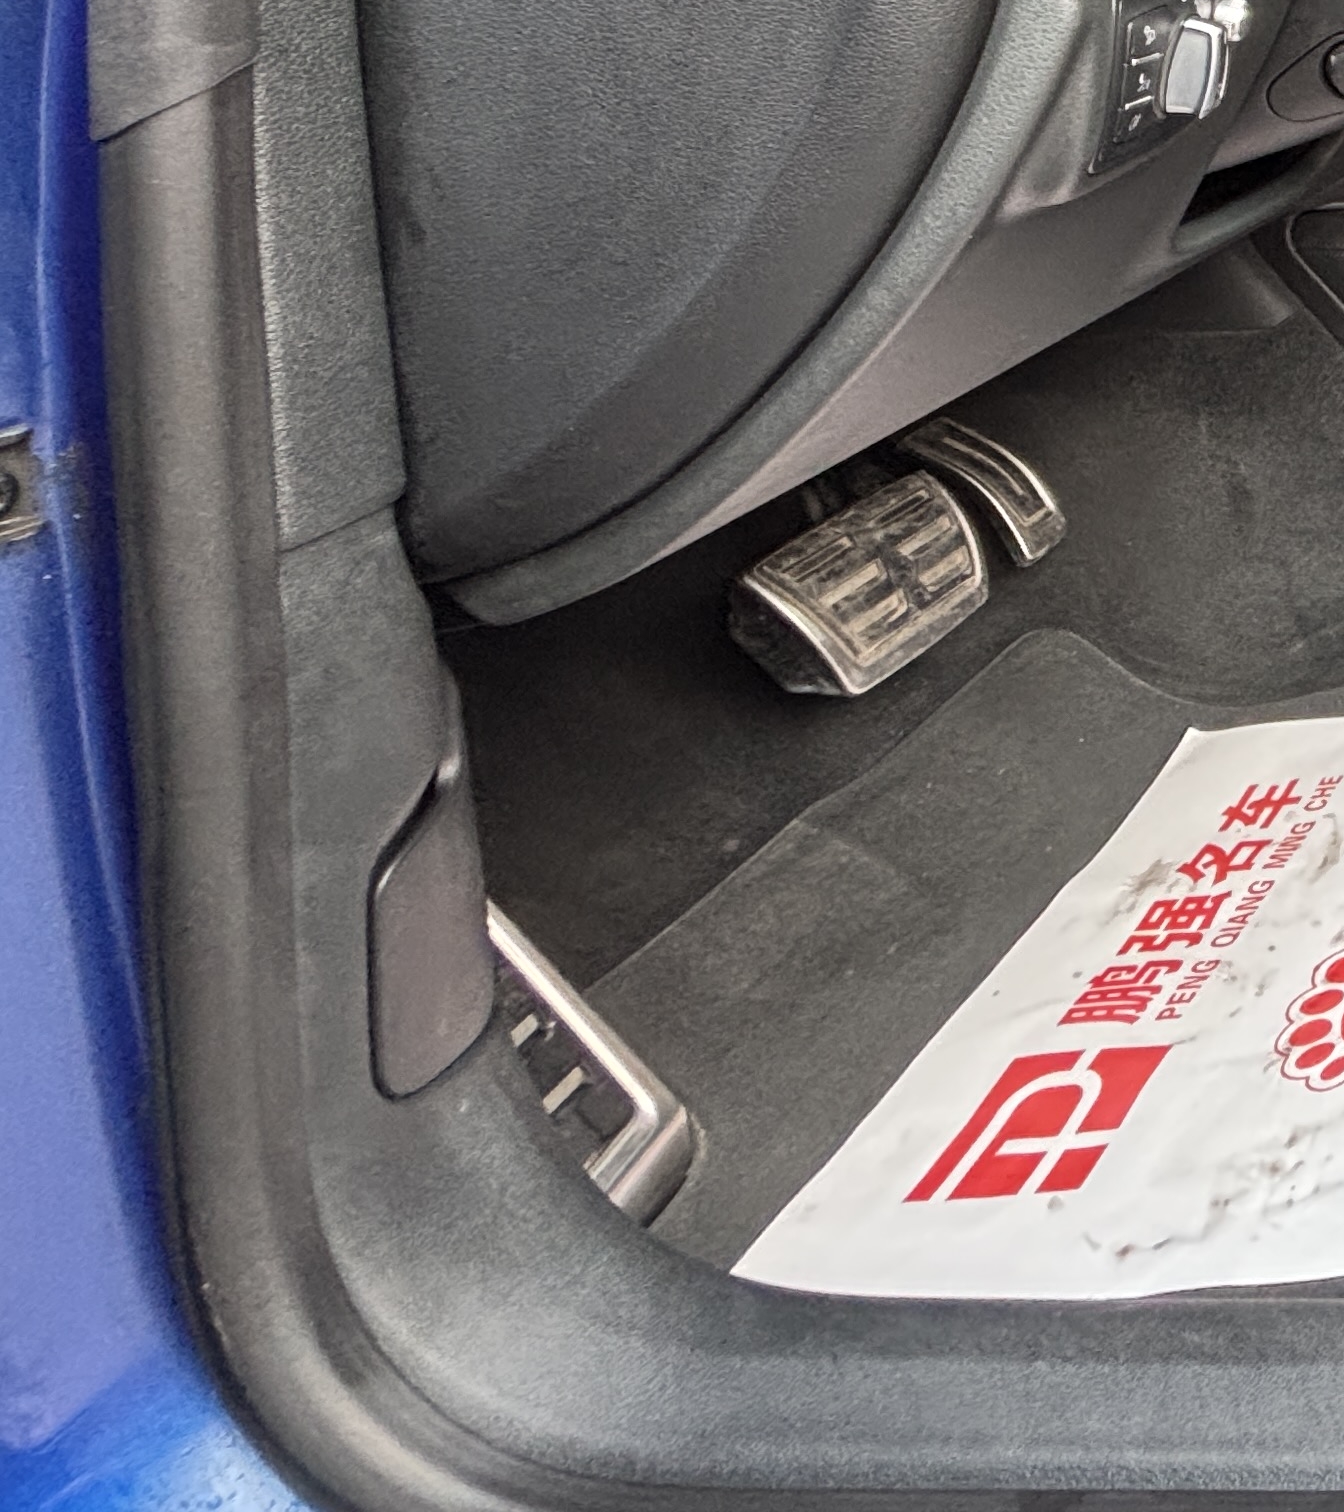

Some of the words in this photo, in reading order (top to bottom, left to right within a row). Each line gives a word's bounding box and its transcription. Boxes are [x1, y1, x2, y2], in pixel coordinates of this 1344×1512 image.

[1056, 777, 1303, 1027] 鹏强名车
[1155, 959, 1222, 1021] PENG
[1210, 879, 1276, 948] QIANG
[1262, 820, 1317, 870] MING
[1303, 774, 1344, 812] CHE
